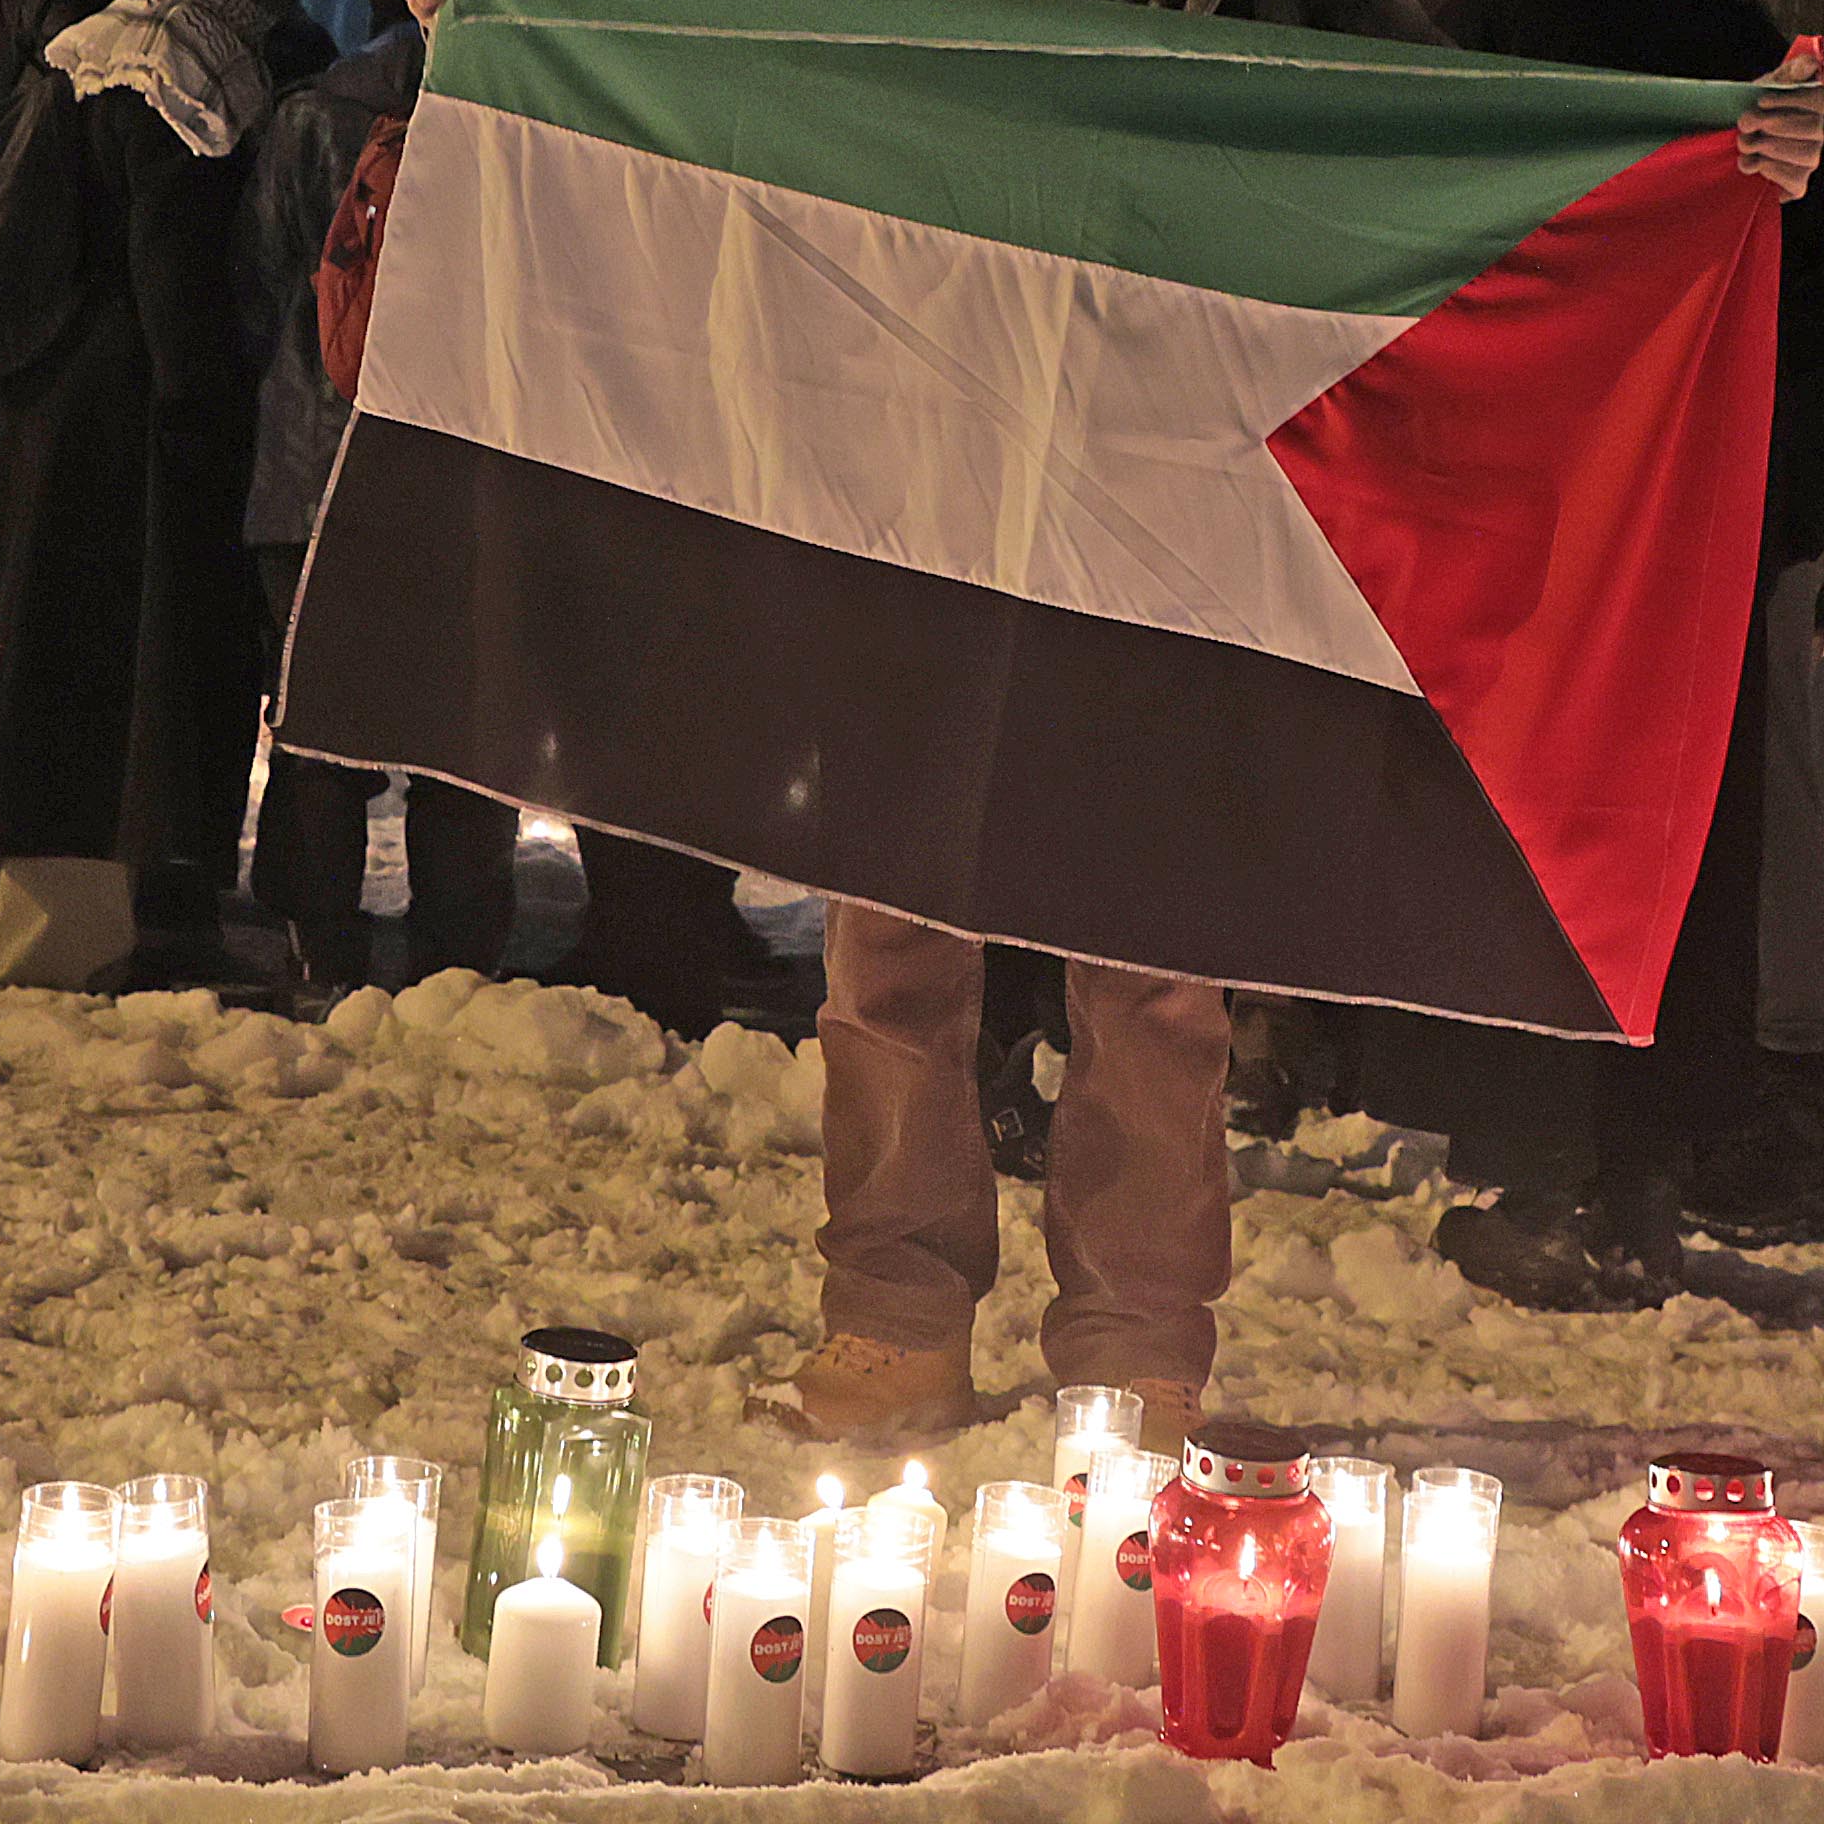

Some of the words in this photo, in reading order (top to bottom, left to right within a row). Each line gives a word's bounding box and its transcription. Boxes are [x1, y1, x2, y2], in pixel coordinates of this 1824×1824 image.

[325, 1613, 360, 1626] DOST
[855, 1633, 891, 1645] DOST
[754, 1641, 789, 1656] DOST
